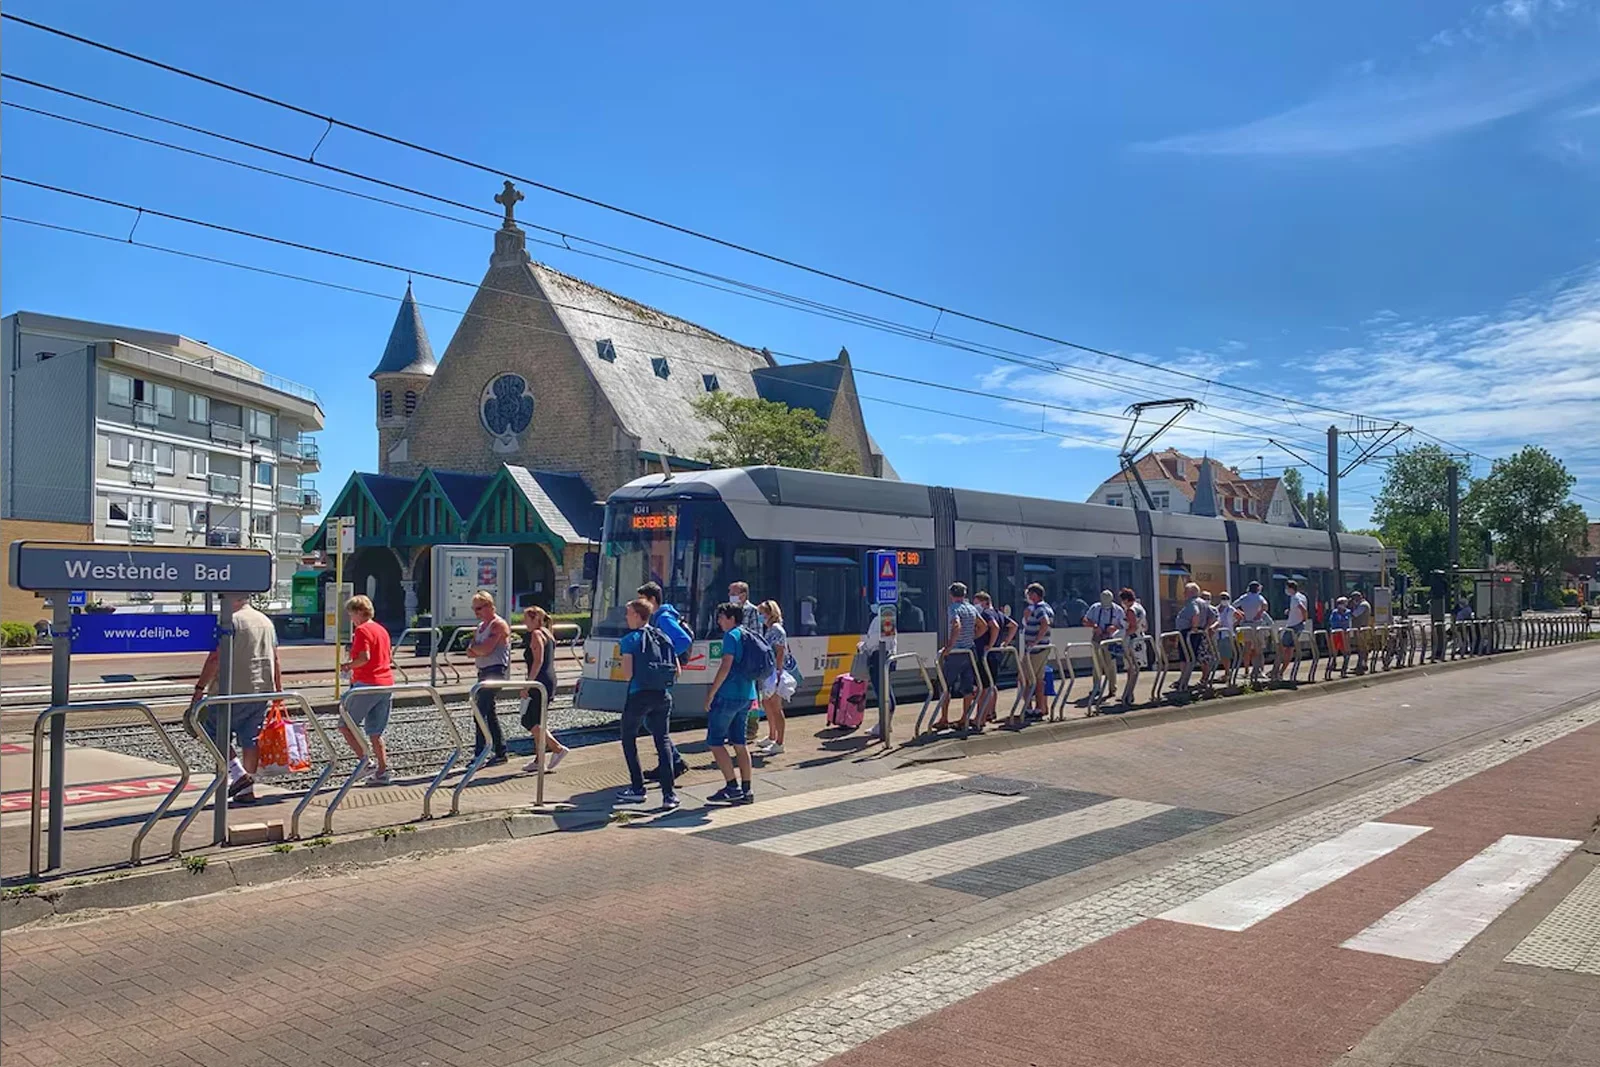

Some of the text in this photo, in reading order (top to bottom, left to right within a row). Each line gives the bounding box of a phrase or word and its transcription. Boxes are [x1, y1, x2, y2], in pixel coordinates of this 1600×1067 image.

[632, 515, 666, 528] WESTENDE
[896, 551, 906, 565] DE
[65, 560, 231, 581] Westende Bad
[104, 626, 190, 640] www.delijn.be
